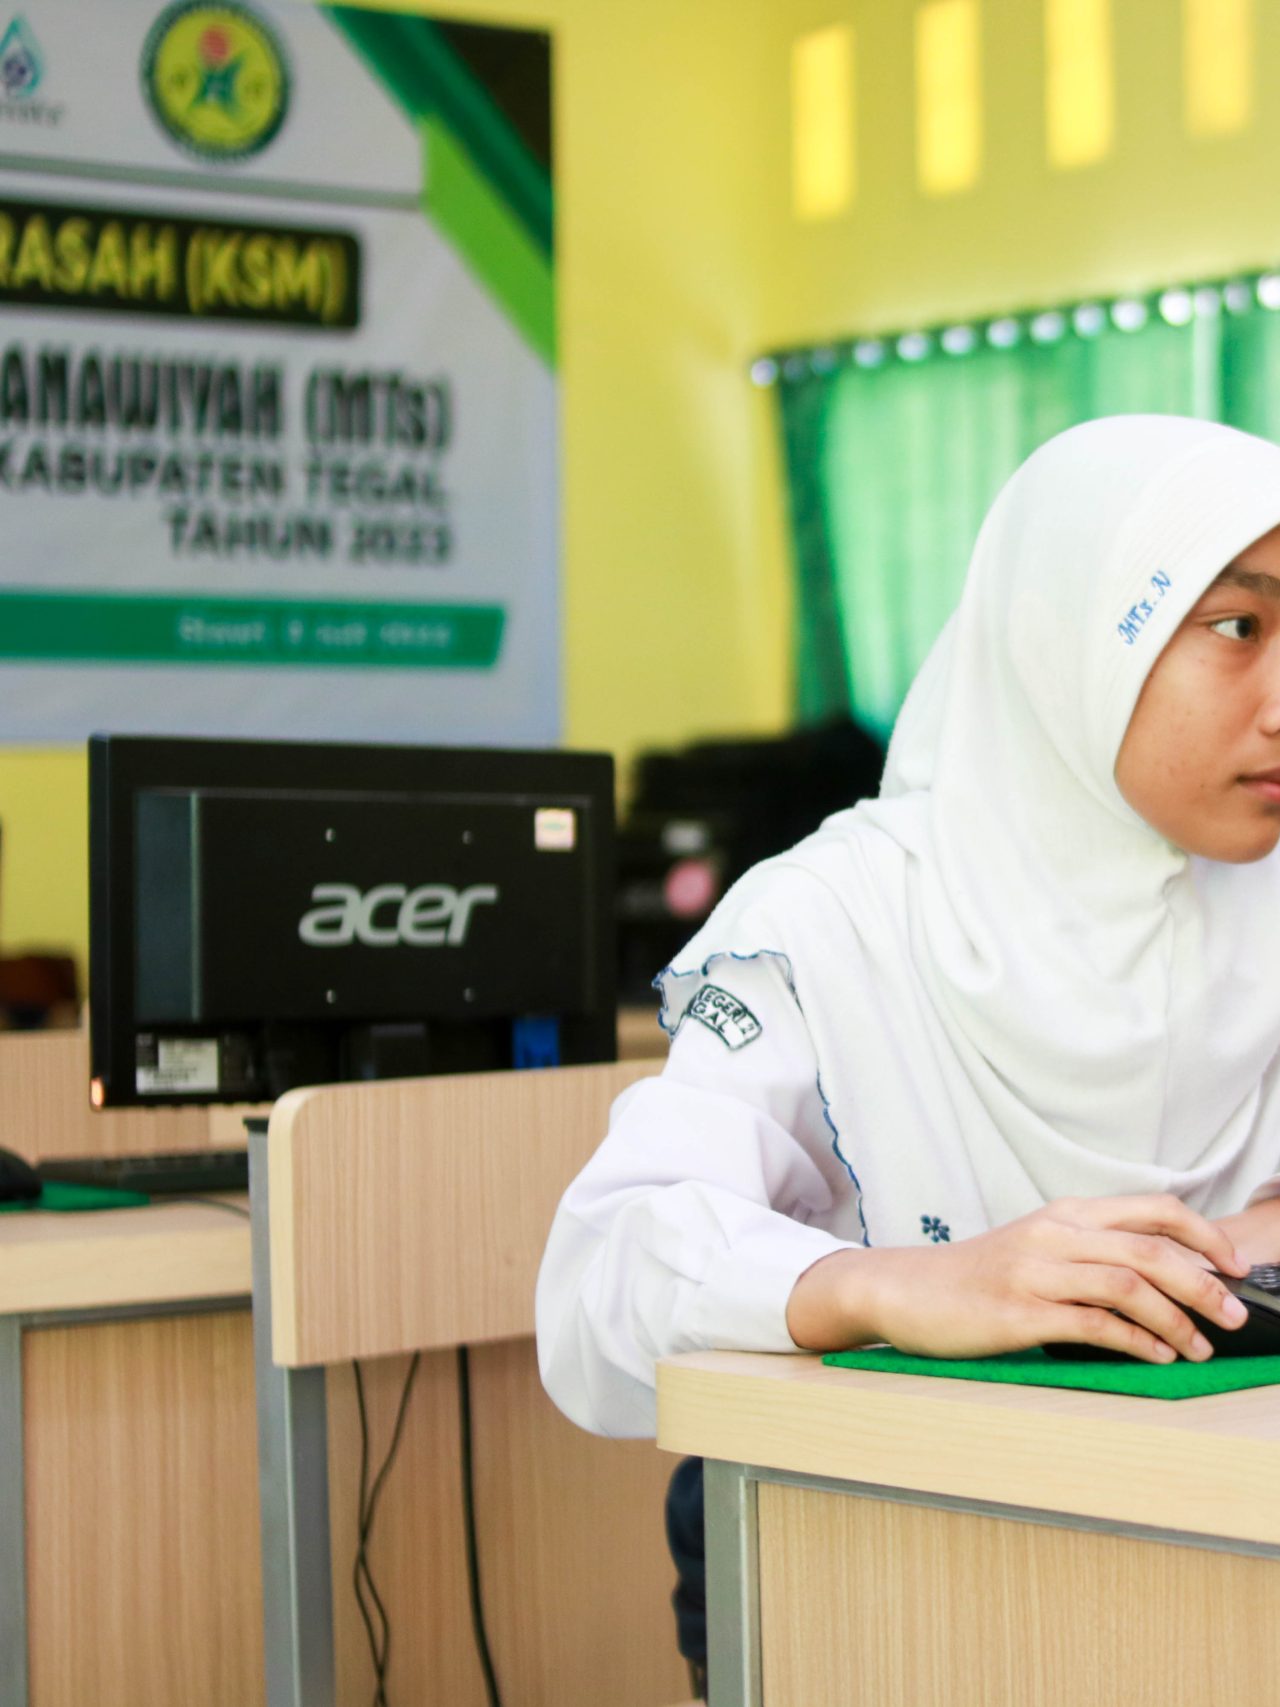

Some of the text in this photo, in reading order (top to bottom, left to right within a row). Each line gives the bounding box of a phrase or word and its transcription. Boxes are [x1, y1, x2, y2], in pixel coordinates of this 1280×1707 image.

[187, 227, 347, 325] (KSM)
[165, 508, 333, 559] TAHUN
[298, 882, 498, 947] acer
[699, 988, 747, 1024] EGERI
